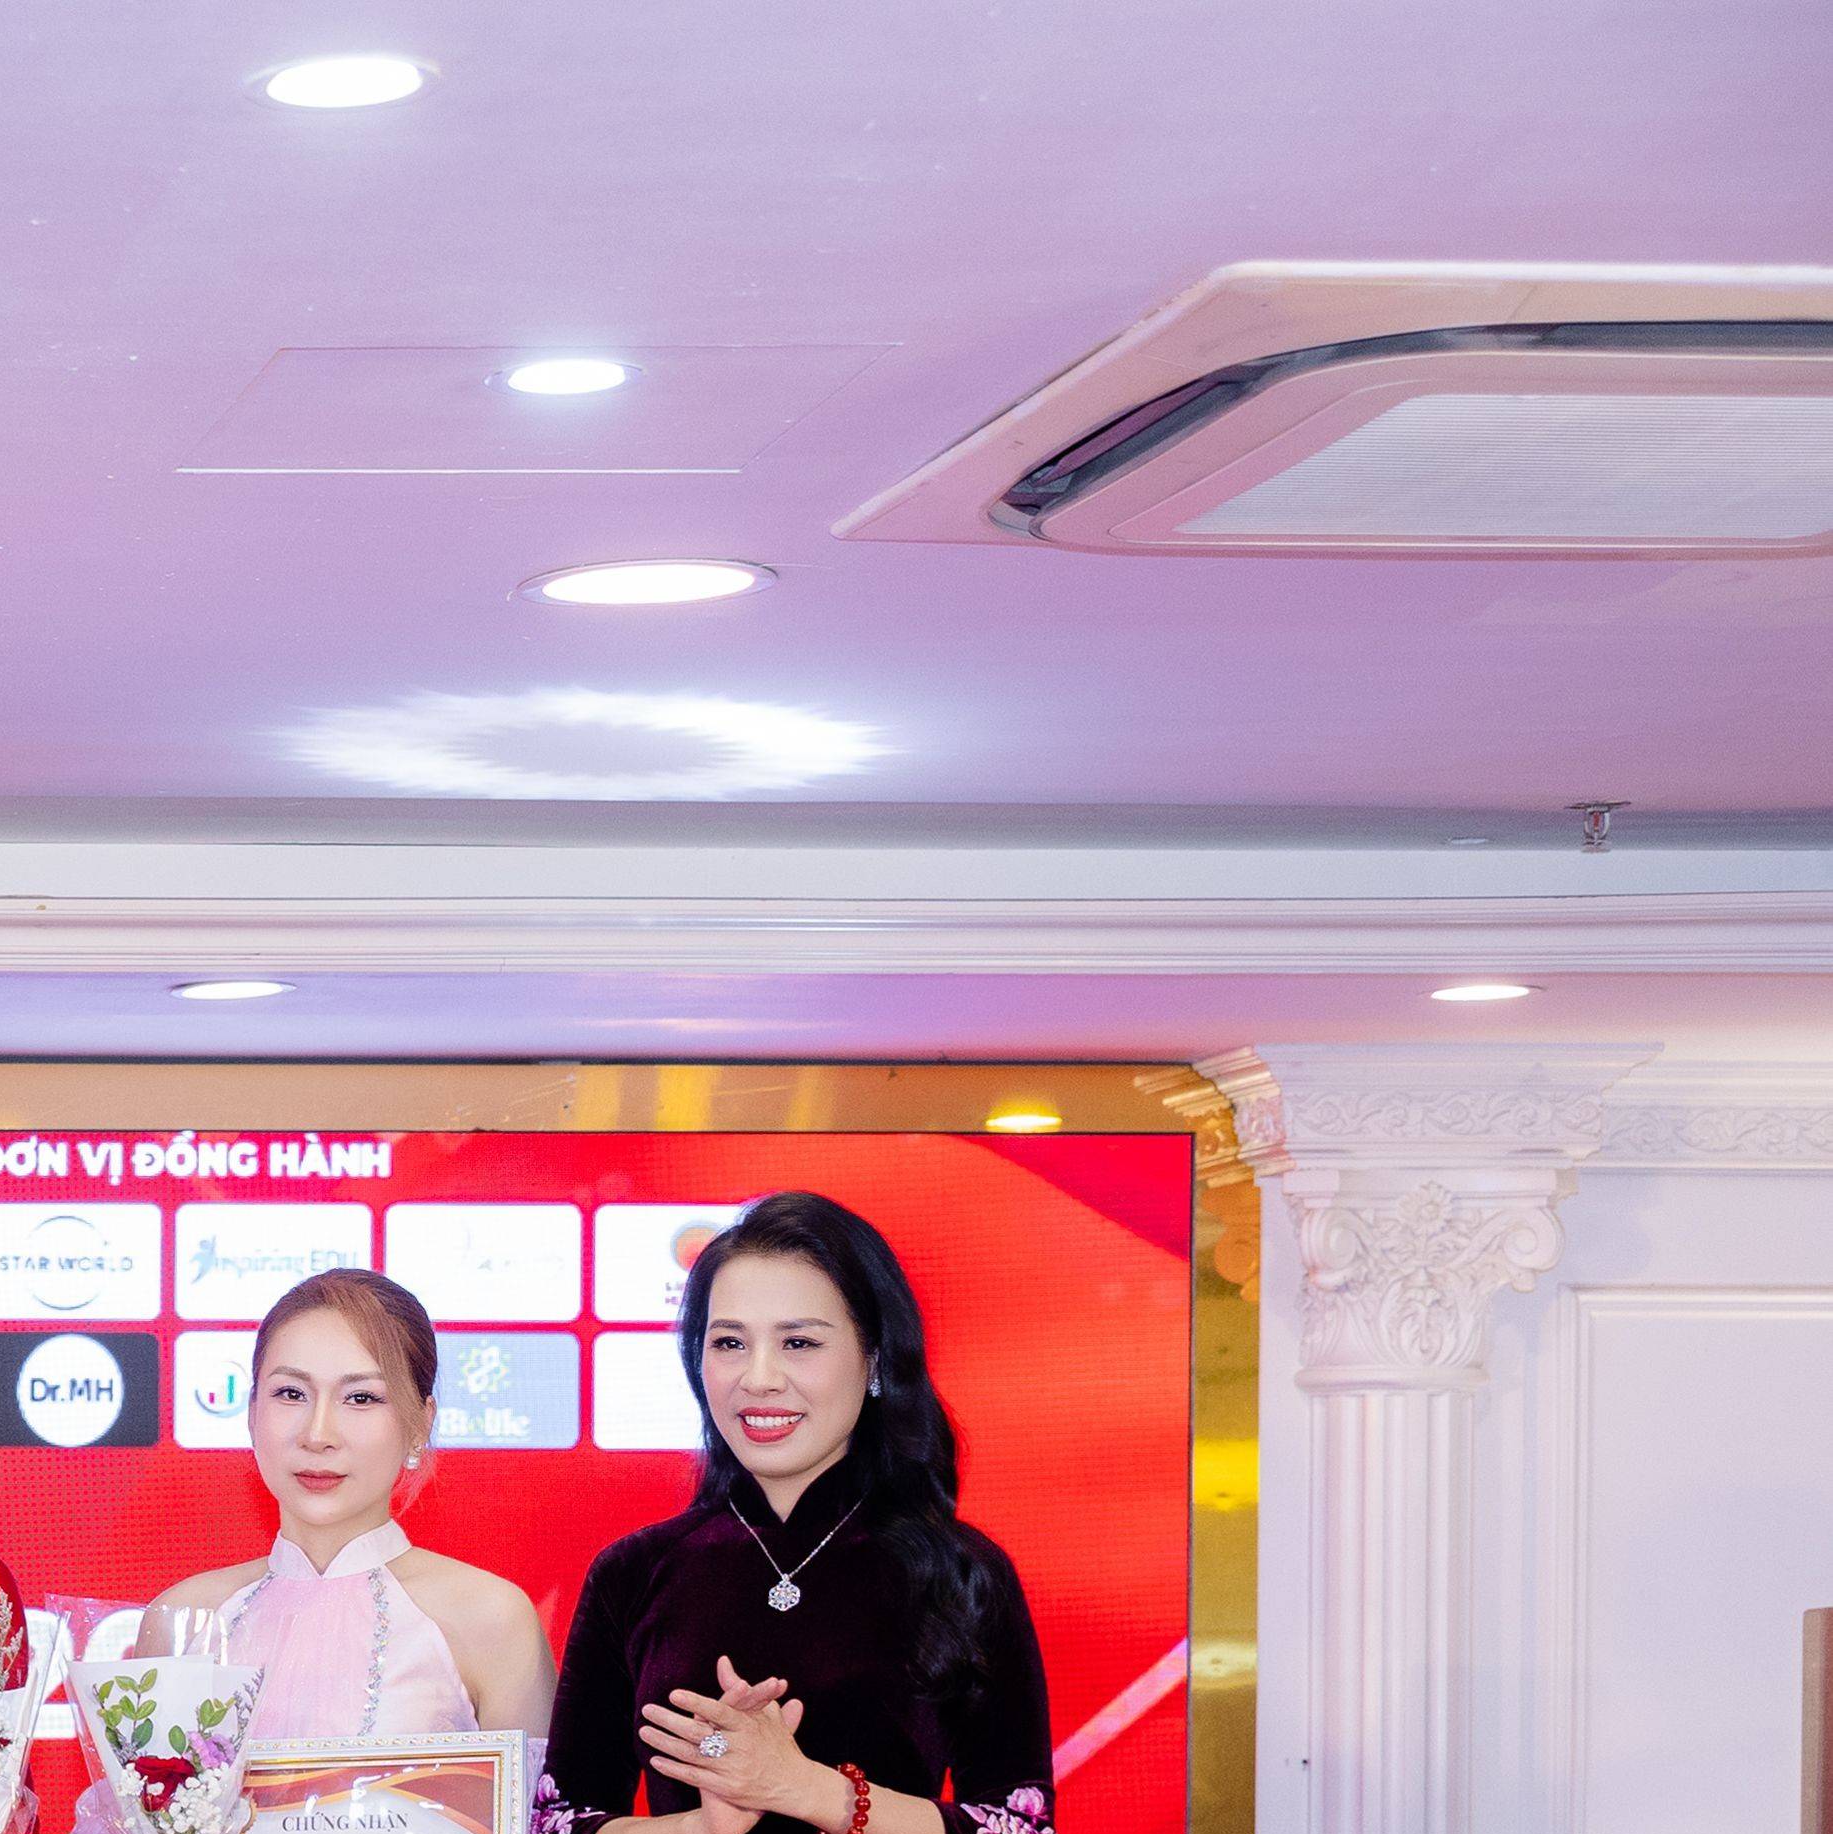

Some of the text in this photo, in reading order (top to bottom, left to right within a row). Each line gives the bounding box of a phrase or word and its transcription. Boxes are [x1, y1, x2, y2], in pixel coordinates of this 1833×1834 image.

[77, 1142, 123, 1186] VỊ
[131, 1130, 259, 1178] ĐỒNG
[269, 1133, 391, 1178] HÀNH
[0, 1256, 50, 1271] STAR
[29, 1378, 114, 1402] Dr.MH
[281, 1810, 408, 1832] CHỨNG NHẬN
